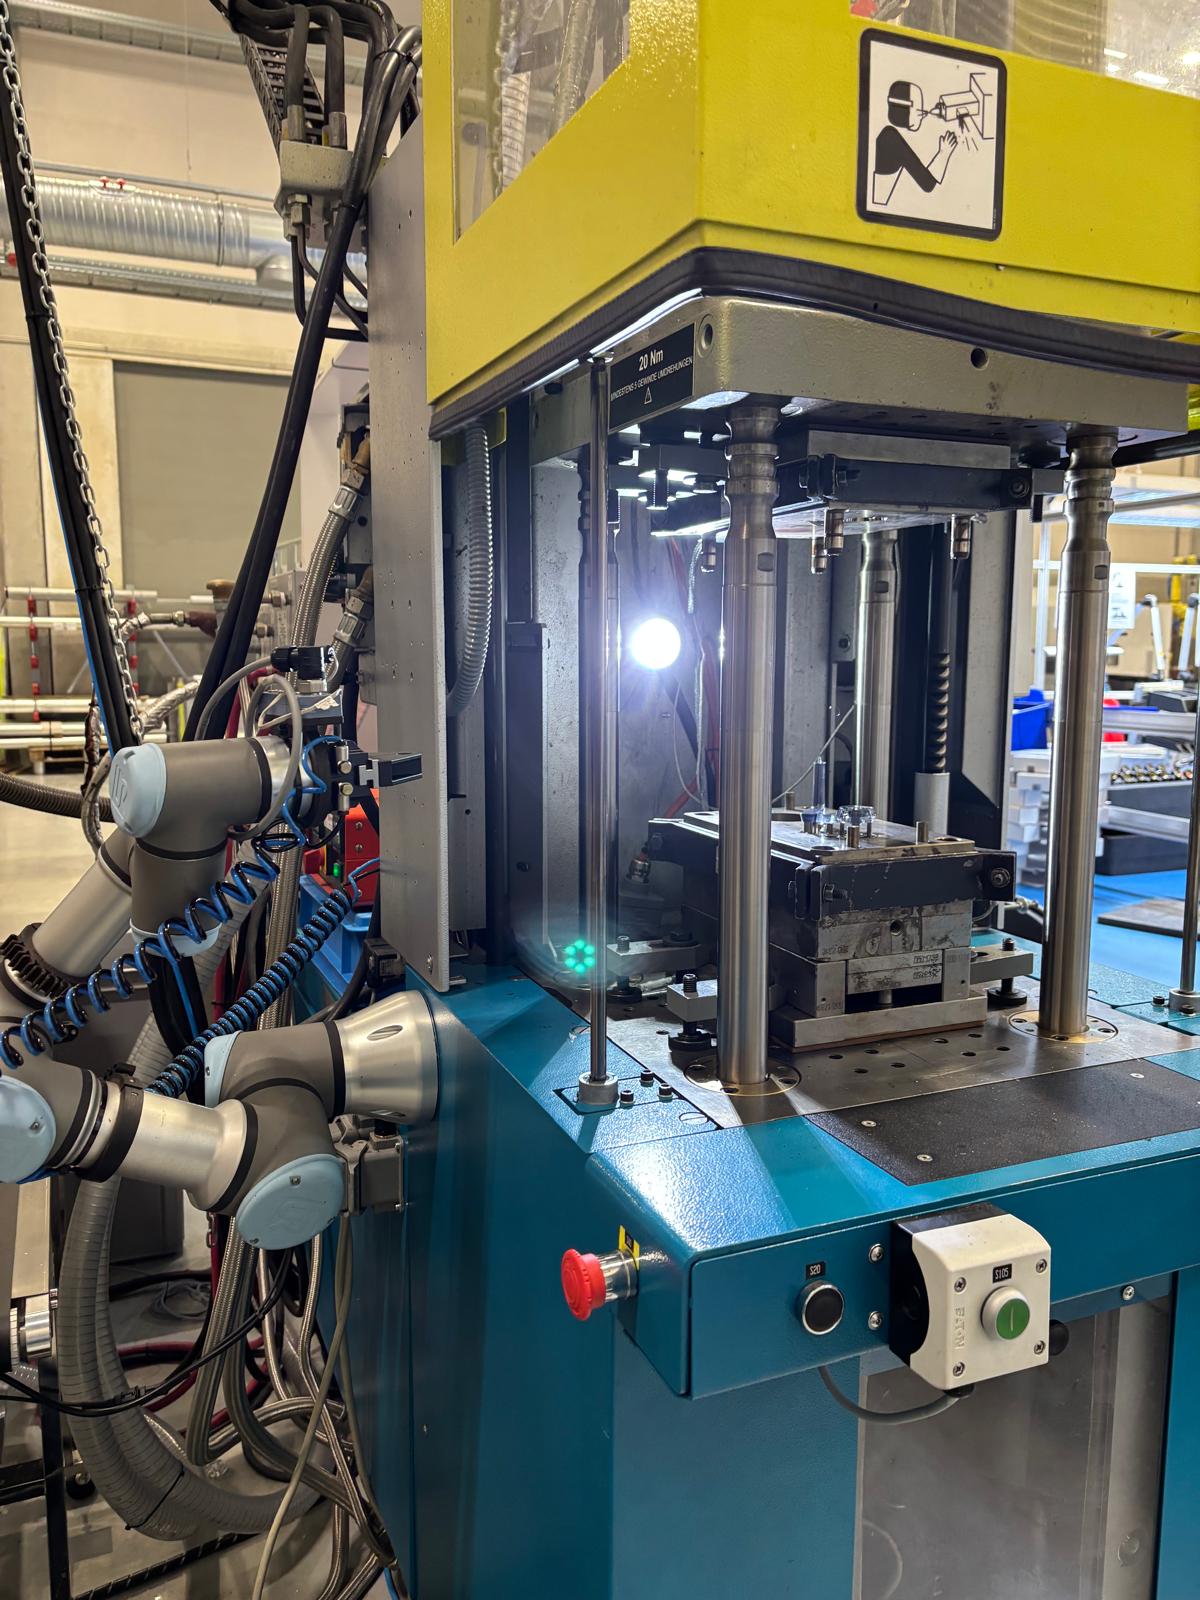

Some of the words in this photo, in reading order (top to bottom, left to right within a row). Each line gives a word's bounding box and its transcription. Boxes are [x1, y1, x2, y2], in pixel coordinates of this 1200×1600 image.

[639, 353, 648, 371] 20
[650, 349, 664, 366] Nm
[611, 383, 634, 401] MINDESTENS
[638, 372, 657, 388] GEWINDE
[658, 357, 693, 379] UMDREHUNGEN
